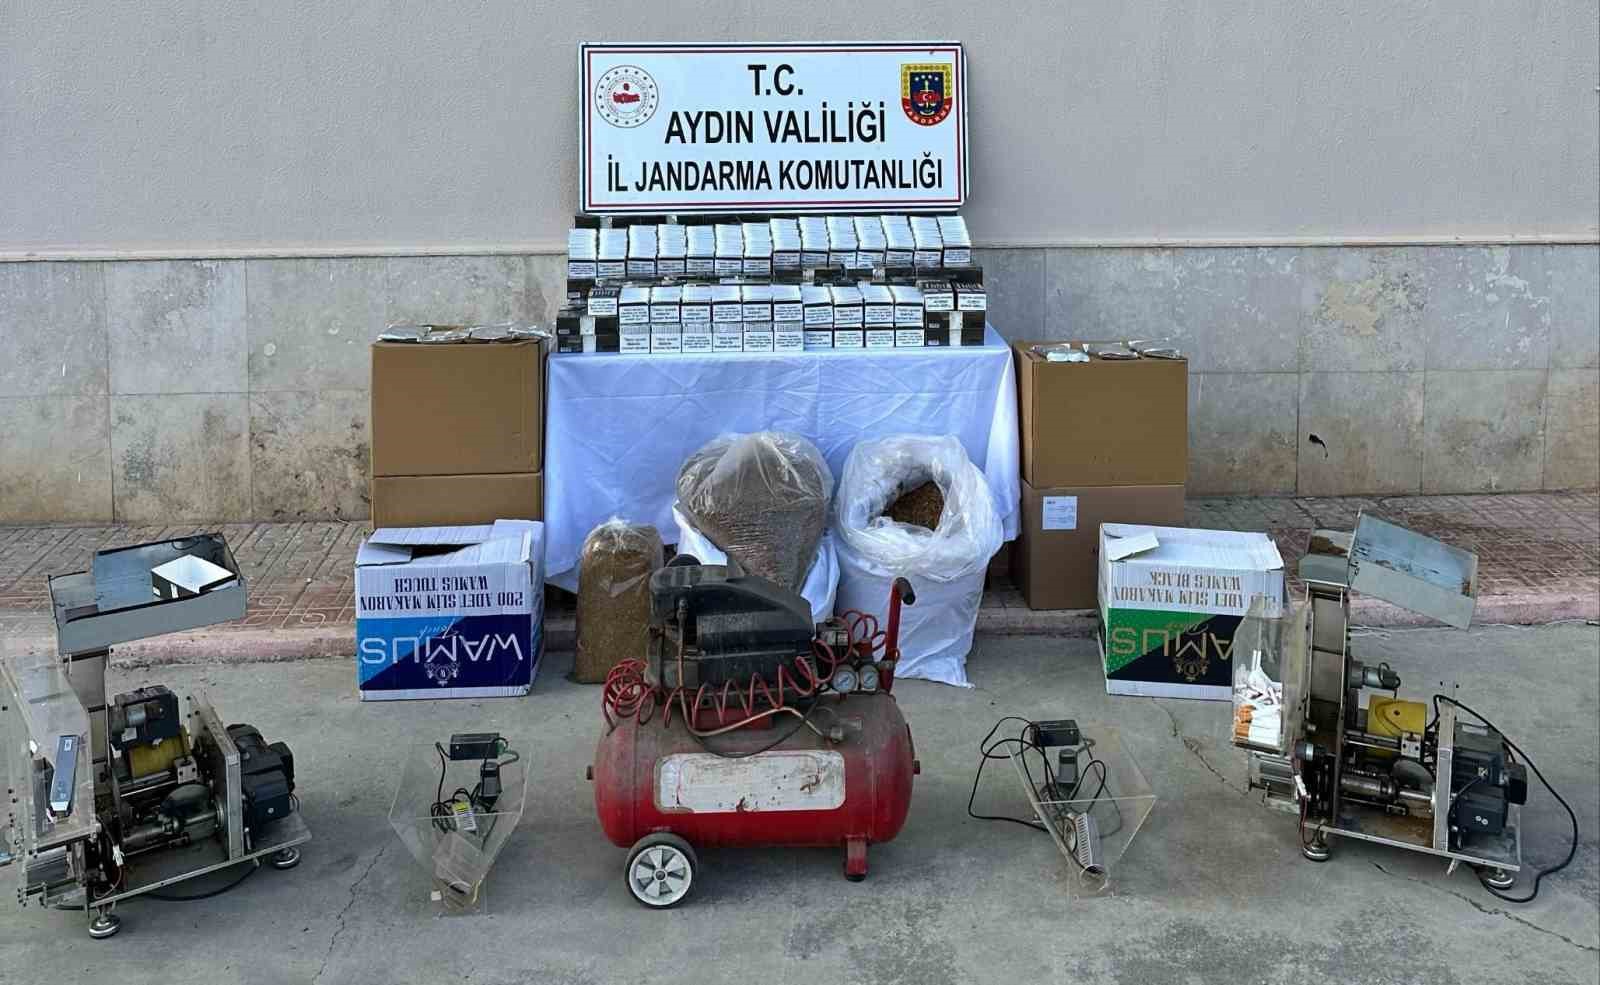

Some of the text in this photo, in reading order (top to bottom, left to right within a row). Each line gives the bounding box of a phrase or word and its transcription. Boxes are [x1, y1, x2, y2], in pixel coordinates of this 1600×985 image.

[747, 63, 803, 96] T.C.
[664, 101, 885, 144] AYDIN VALİLİĞİ
[607, 151, 943, 192] İL JANDARMA KOMUTANLIĞI
[394, 575, 488, 594] WAMUS TOUCH
[1150, 570, 1191, 587] BLACK
[360, 594, 422, 612] MAKARON
[460, 593, 492, 609] ADET
[497, 591, 523, 606] 200
[1113, 586, 1173, 604] MAKARON
[1215, 592, 1243, 609] ADET
[360, 633, 523, 664] WAMUS
[1111, 625, 1233, 660] AMUS
